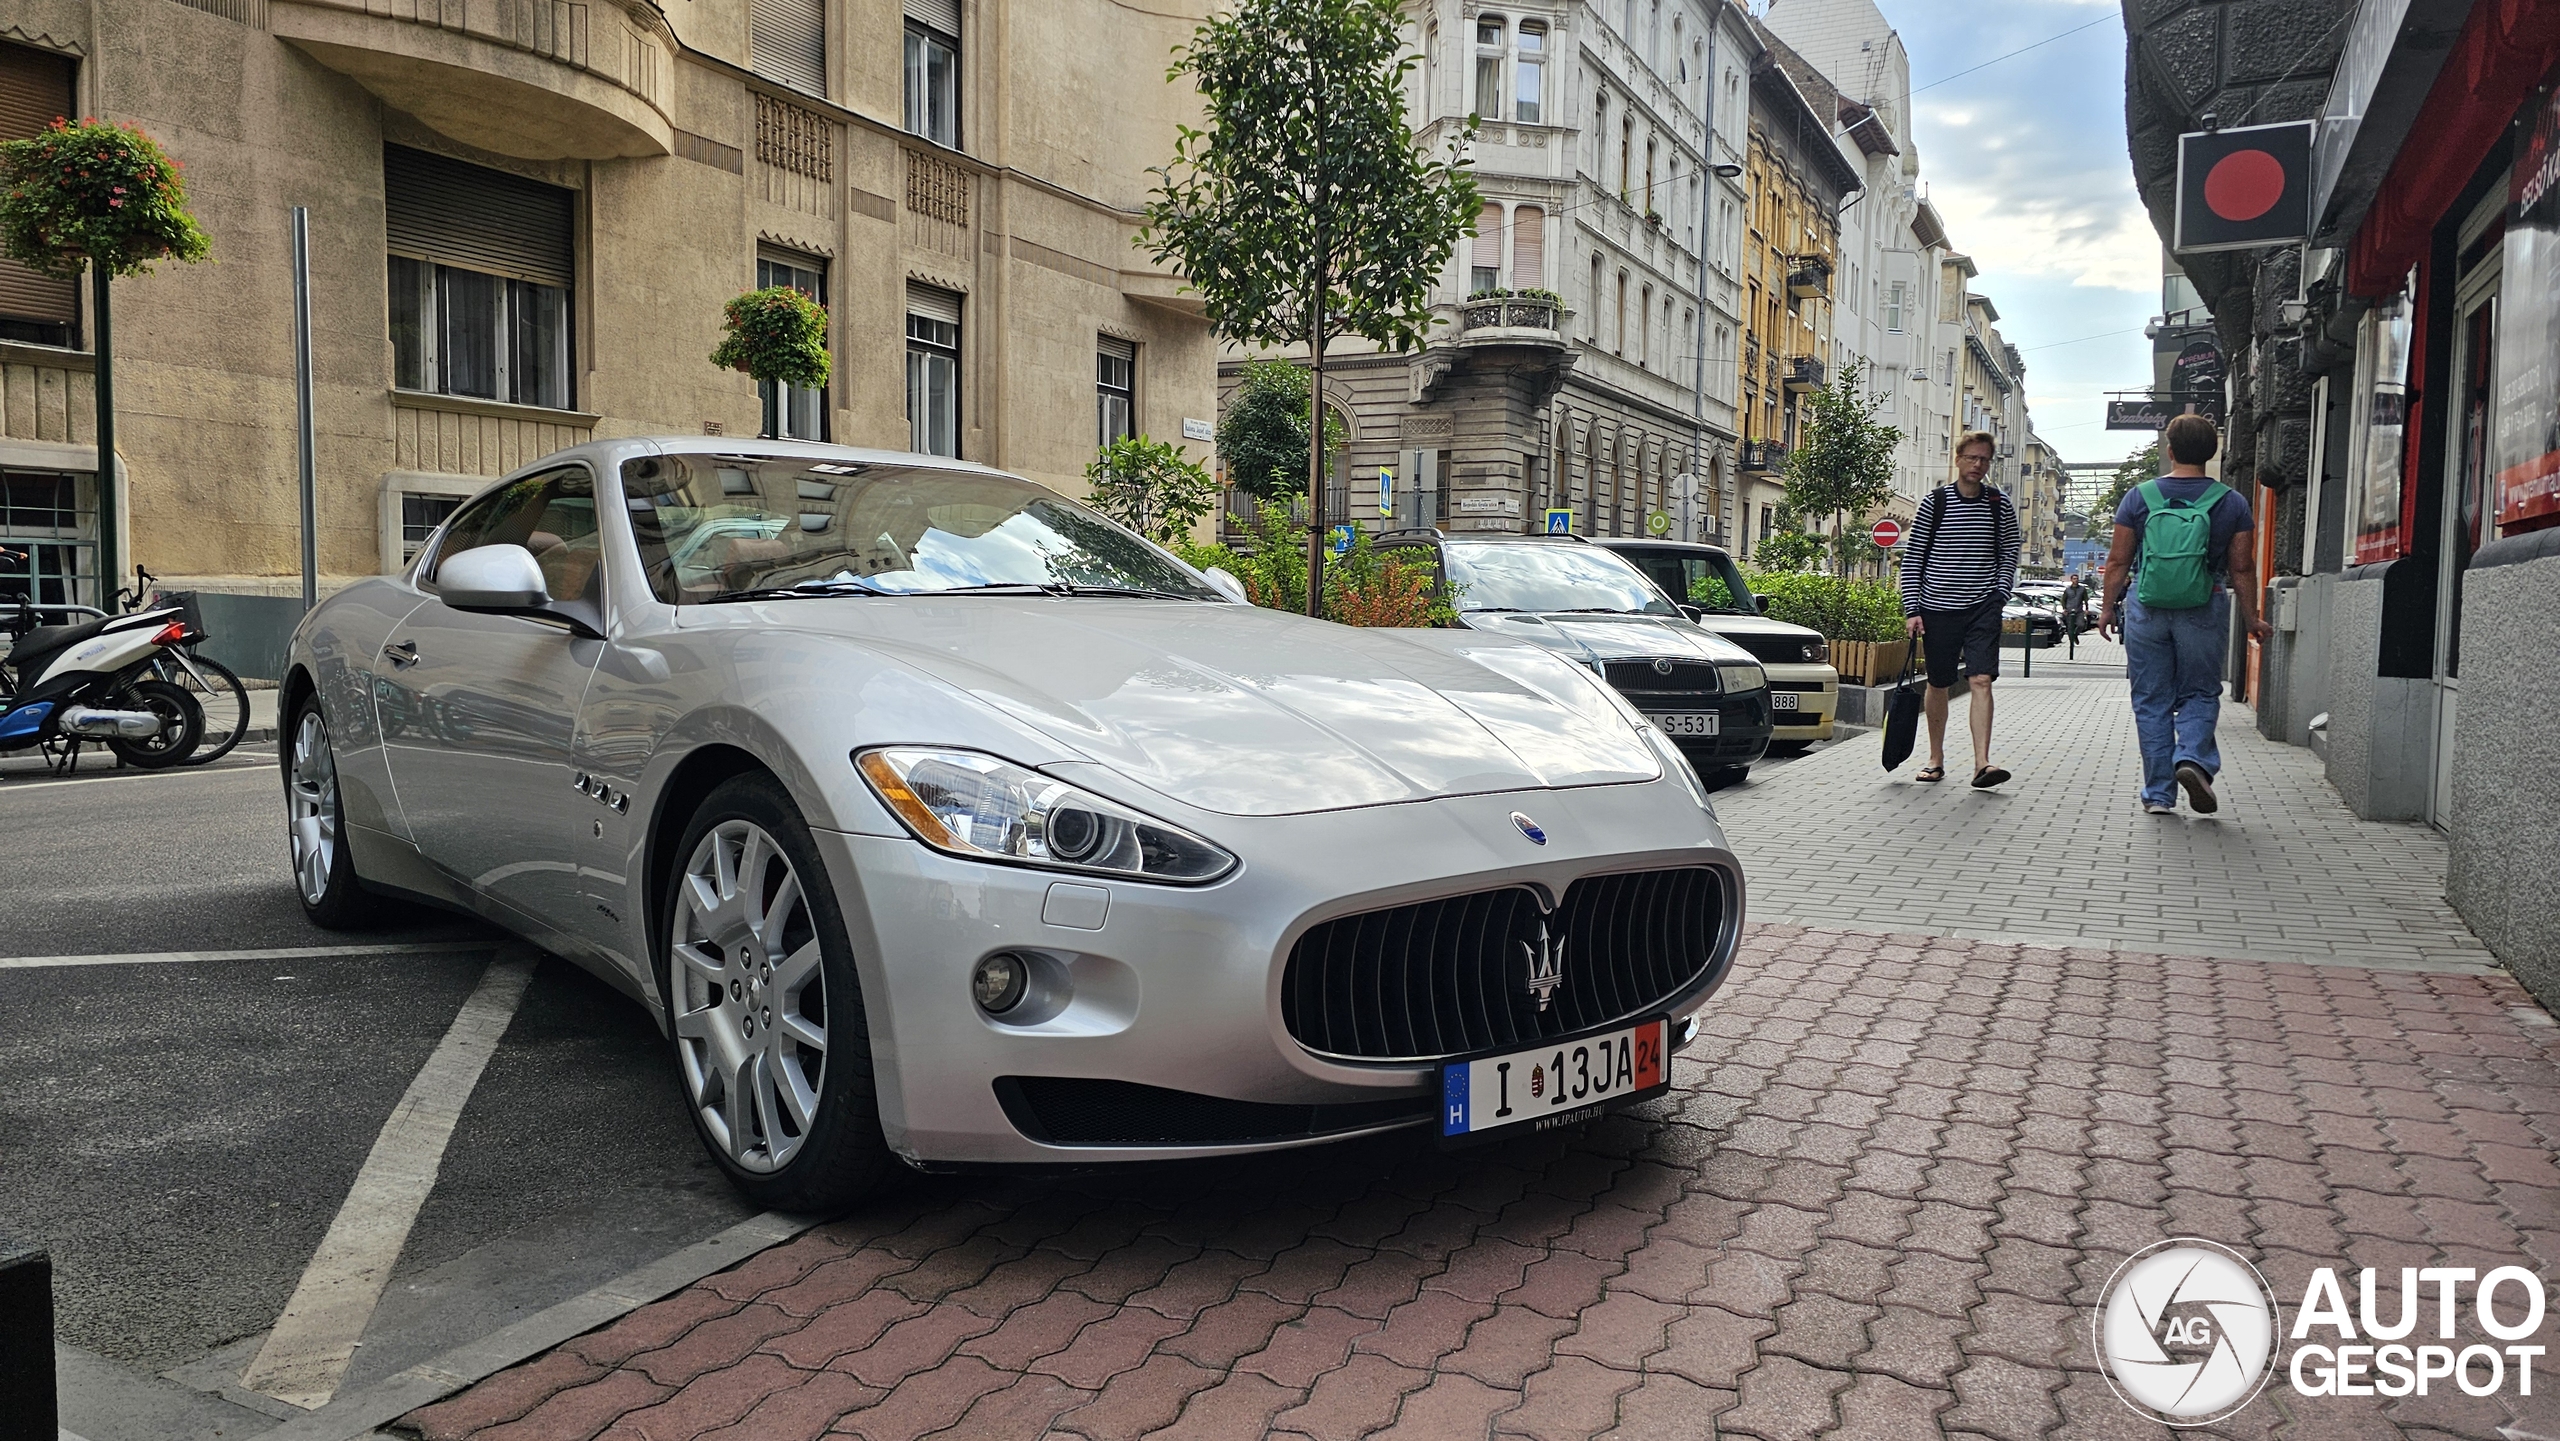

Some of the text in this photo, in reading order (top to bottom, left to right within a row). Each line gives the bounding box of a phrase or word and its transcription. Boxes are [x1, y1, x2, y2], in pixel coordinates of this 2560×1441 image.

[1774, 696, 1795, 708] 888
[1495, 1036, 1660, 1117] I 13JA 24
[1450, 1103, 1463, 1125] H
[1535, 1105, 1605, 1132] WWW.JPAUTO.HU
